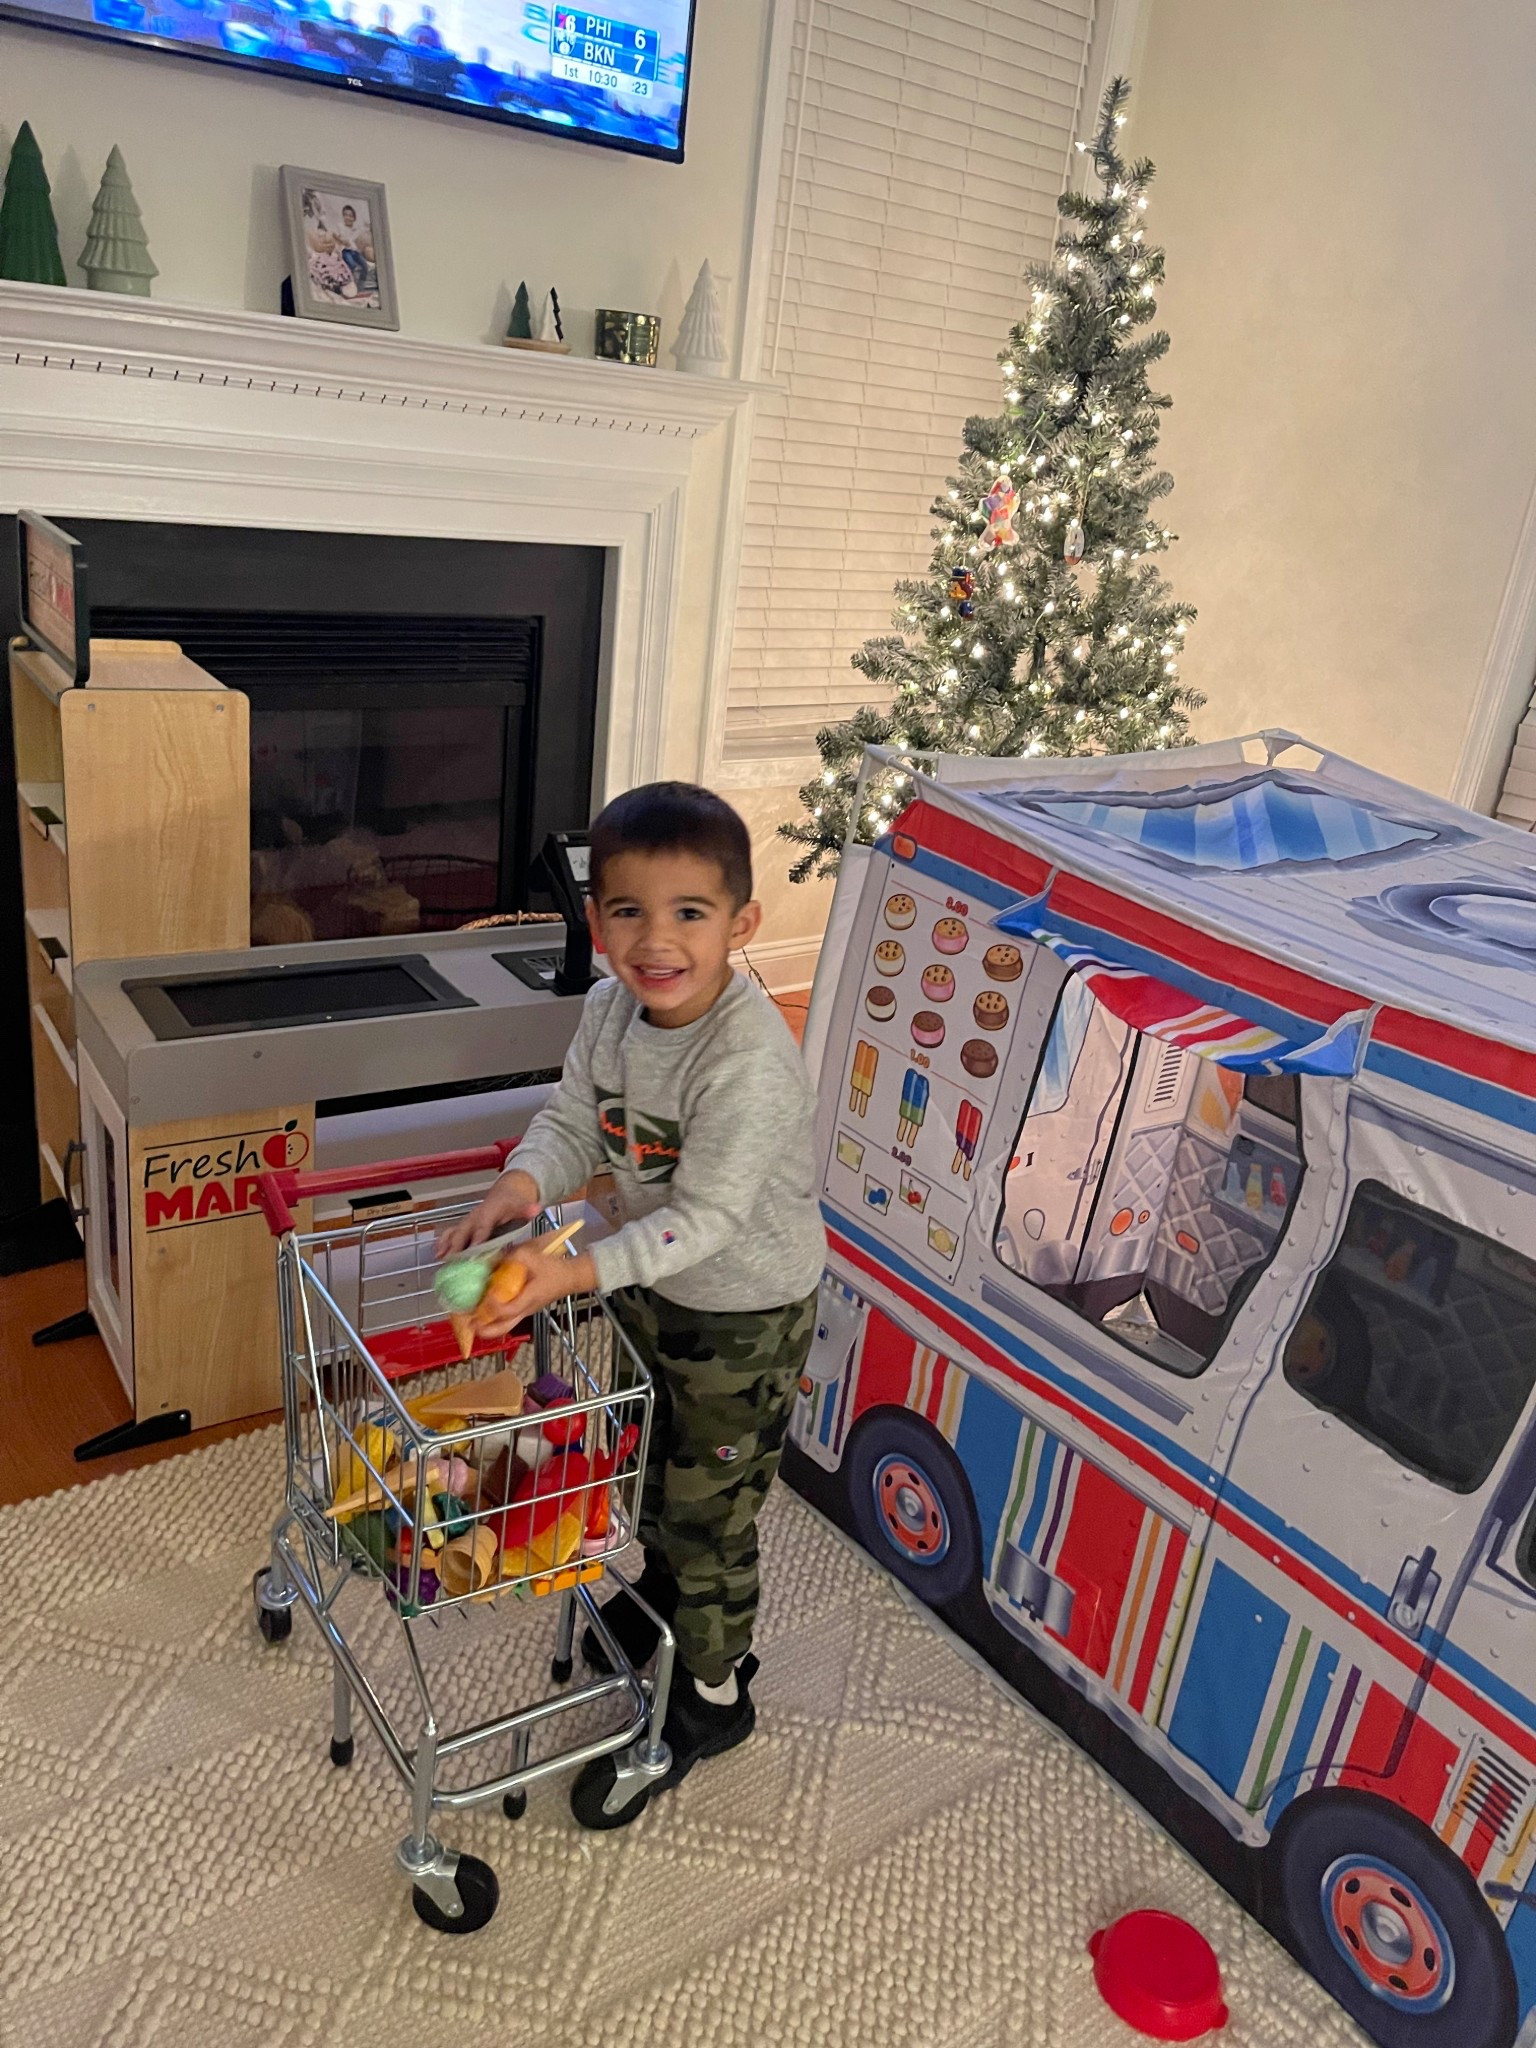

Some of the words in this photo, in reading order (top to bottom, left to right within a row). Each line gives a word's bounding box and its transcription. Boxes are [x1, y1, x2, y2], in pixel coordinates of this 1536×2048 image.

[586, 16, 612, 38] PHI
[635, 29, 646, 49] 6
[584, 42, 615, 66] BKN
[633, 54, 645, 74] 7
[347, 77, 363, 87] TCL
[564, 64, 578, 79] 1st
[589, 70, 618, 88] 10:30
[632, 81, 648, 95] :23
[143, 1139, 261, 1188] Fresh
[145, 1168, 299, 1228] MAR
